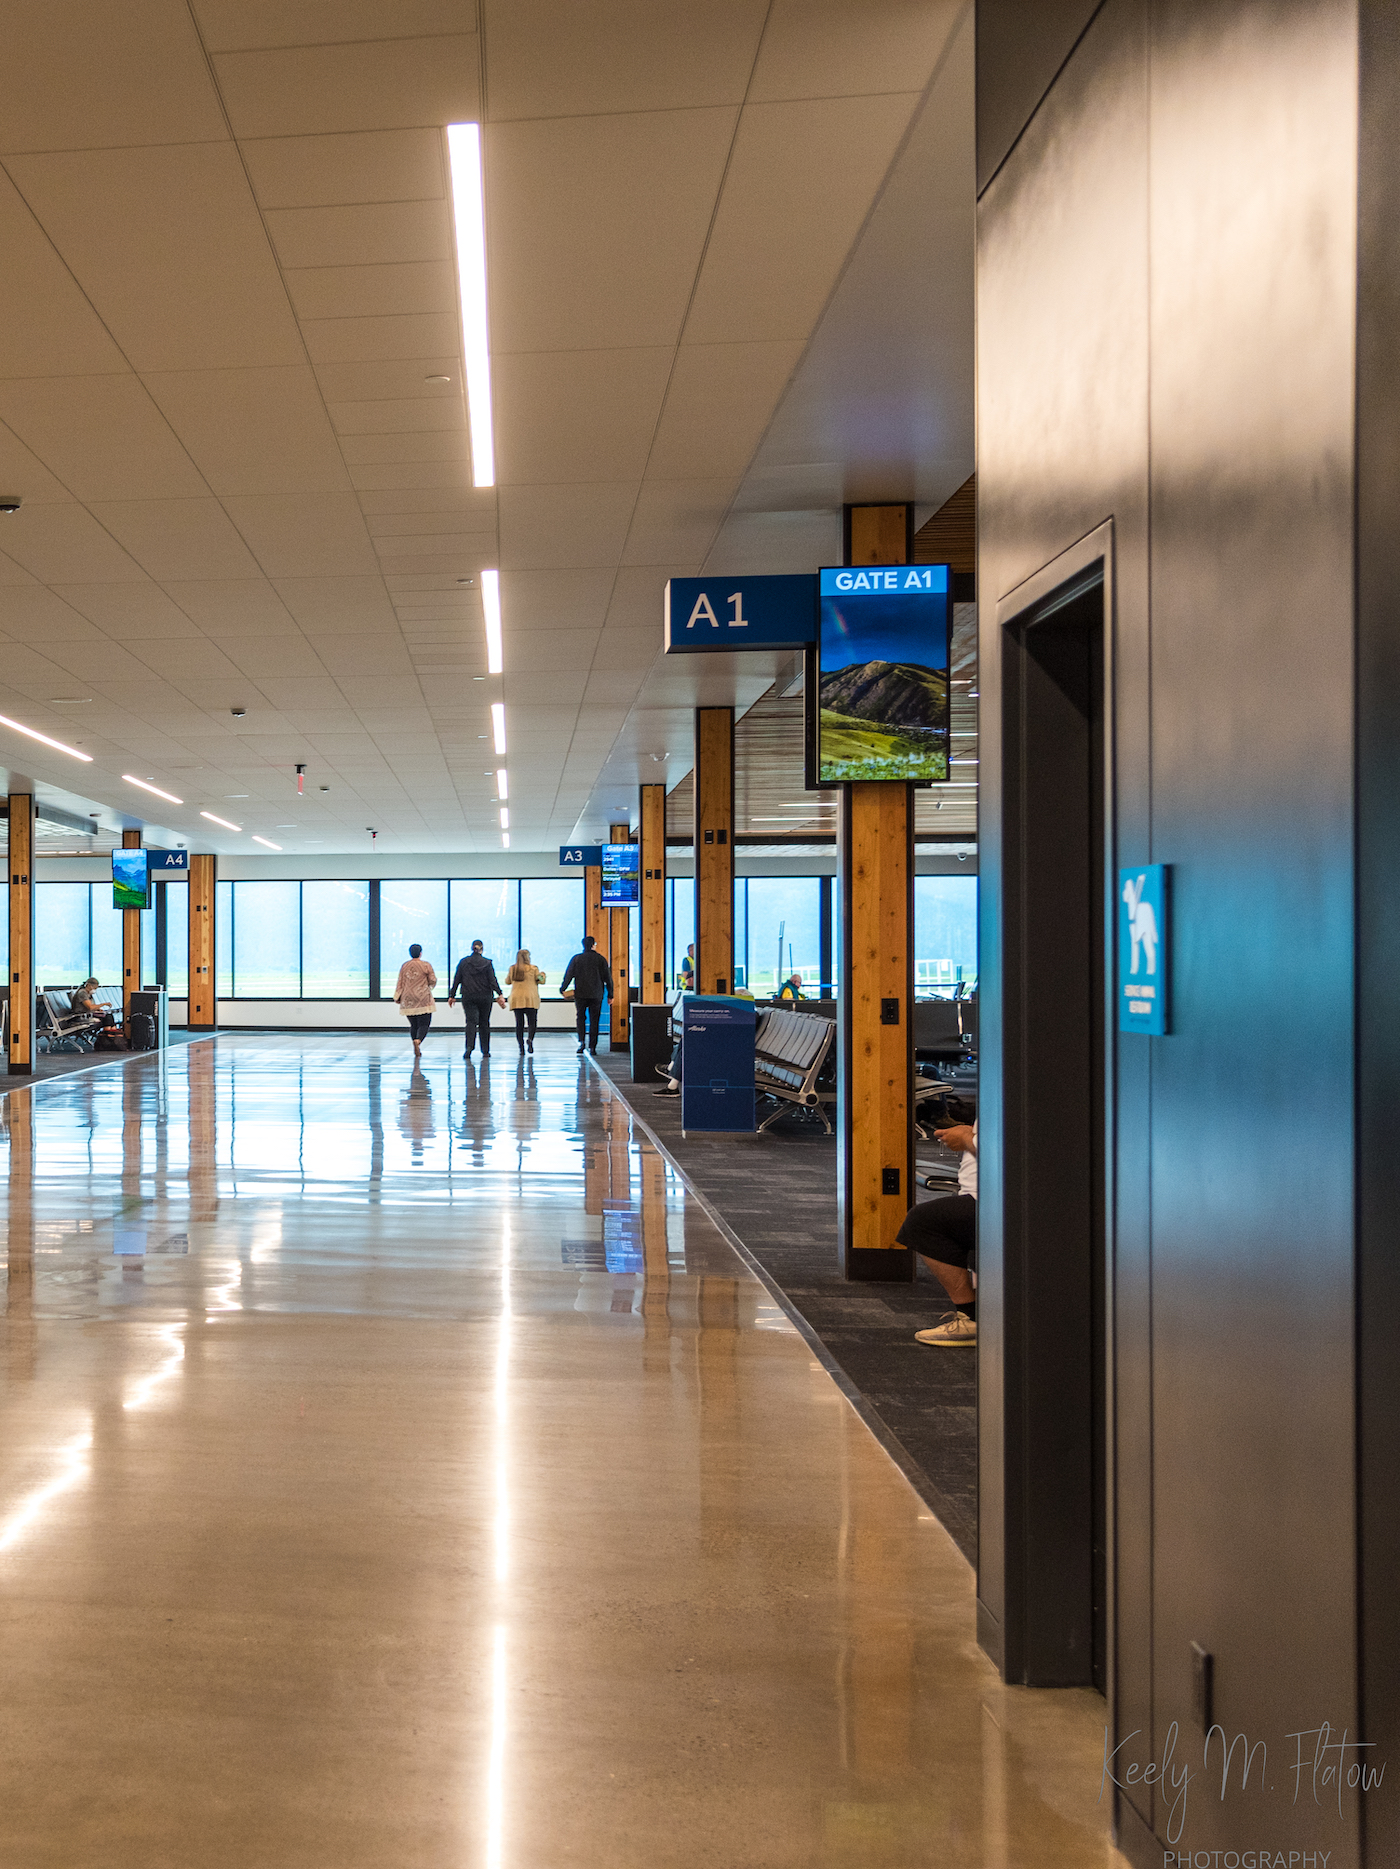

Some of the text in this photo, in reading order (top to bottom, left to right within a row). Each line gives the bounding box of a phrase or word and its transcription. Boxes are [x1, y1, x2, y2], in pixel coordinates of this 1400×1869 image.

[835, 570, 932, 591] GATE A1
[686, 592, 749, 628] A1
[165, 854, 184, 865] A4
[564, 850, 583, 862] A3
